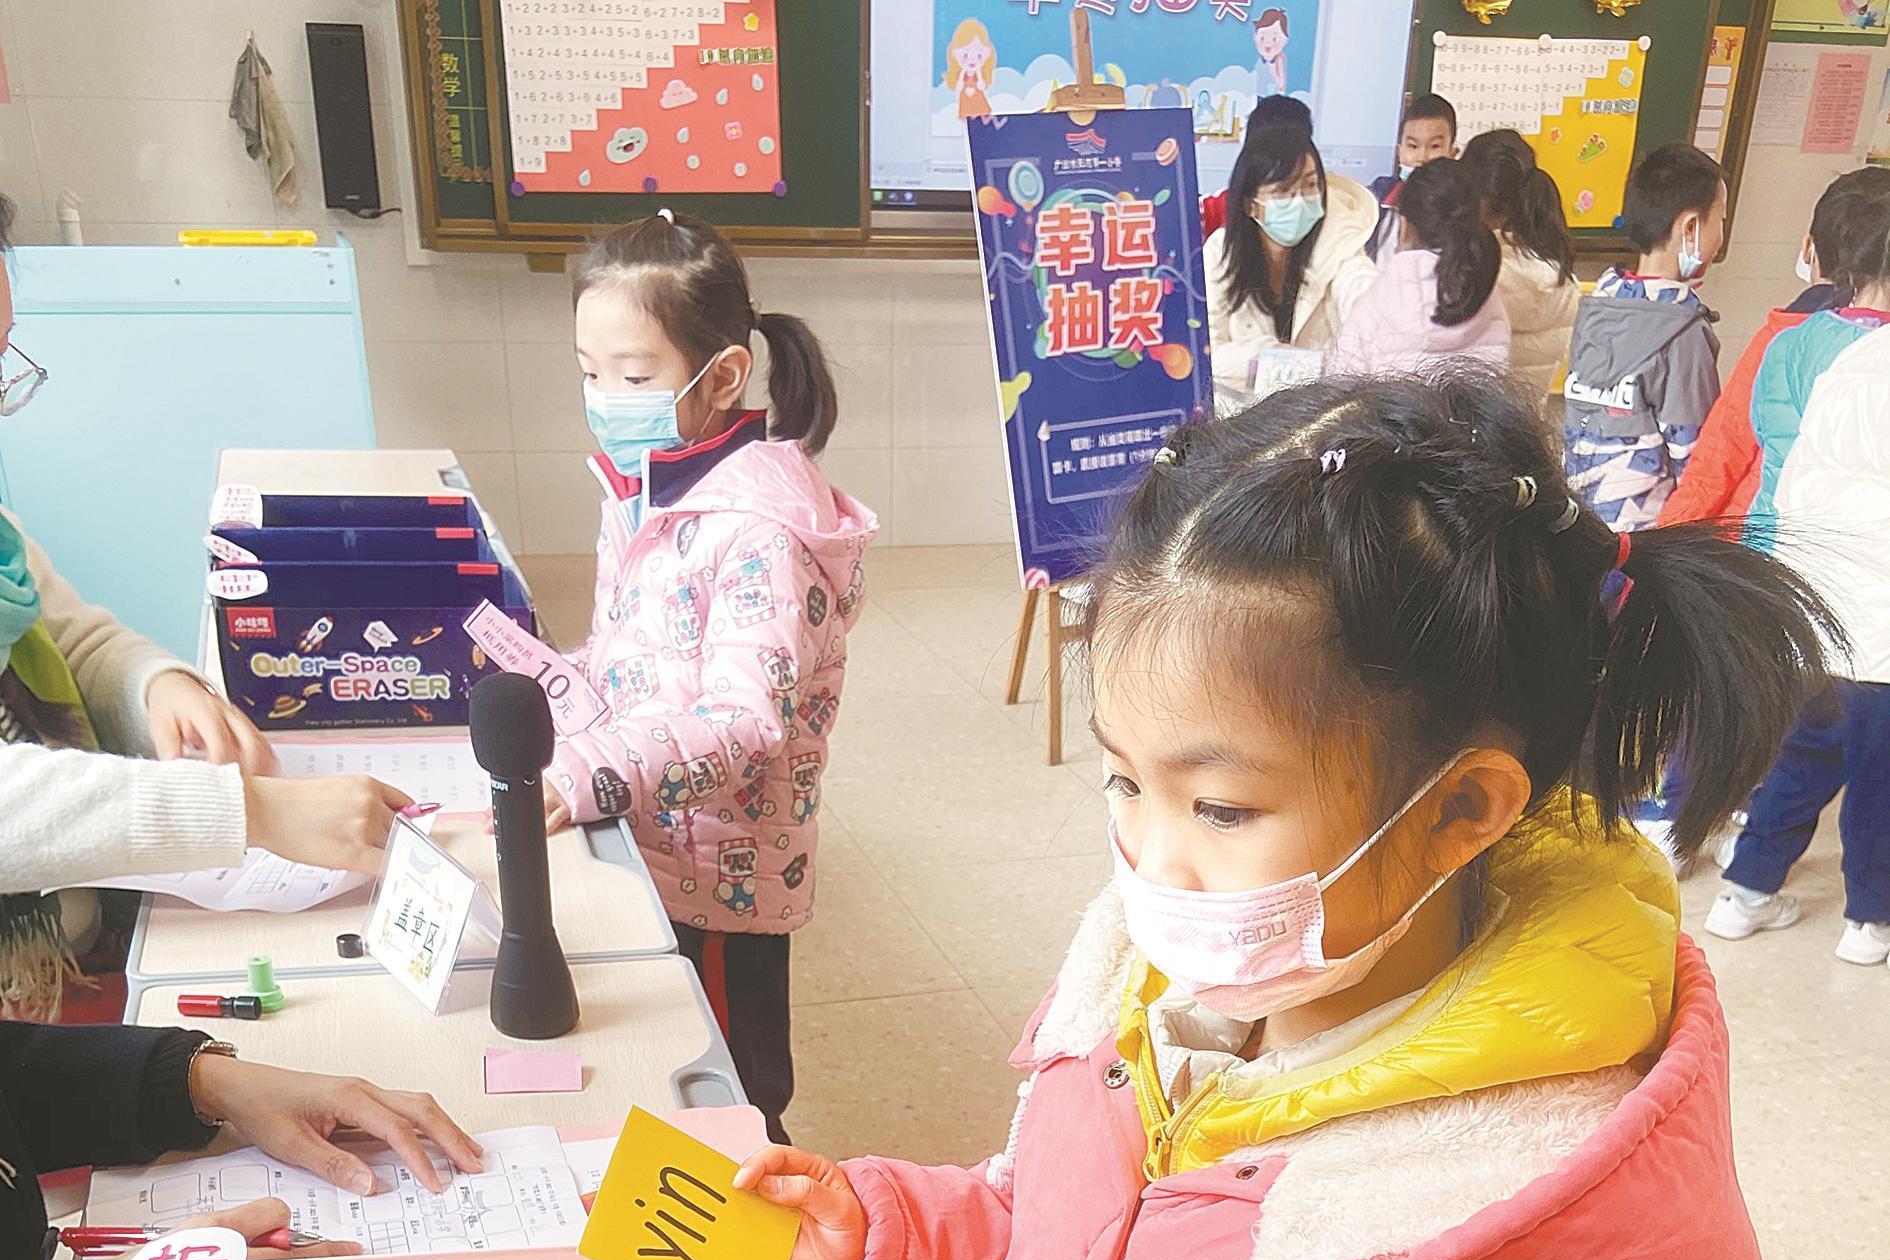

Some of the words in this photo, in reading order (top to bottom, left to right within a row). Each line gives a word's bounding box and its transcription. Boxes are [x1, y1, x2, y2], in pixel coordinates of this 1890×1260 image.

[441, 53, 461, 97] 数学
[1036, 200, 1158, 275] 幸运
[1046, 277, 1163, 356] 抽奖
[252, 653, 420, 677] Outer-Space
[331, 676, 450, 699] ERASER
